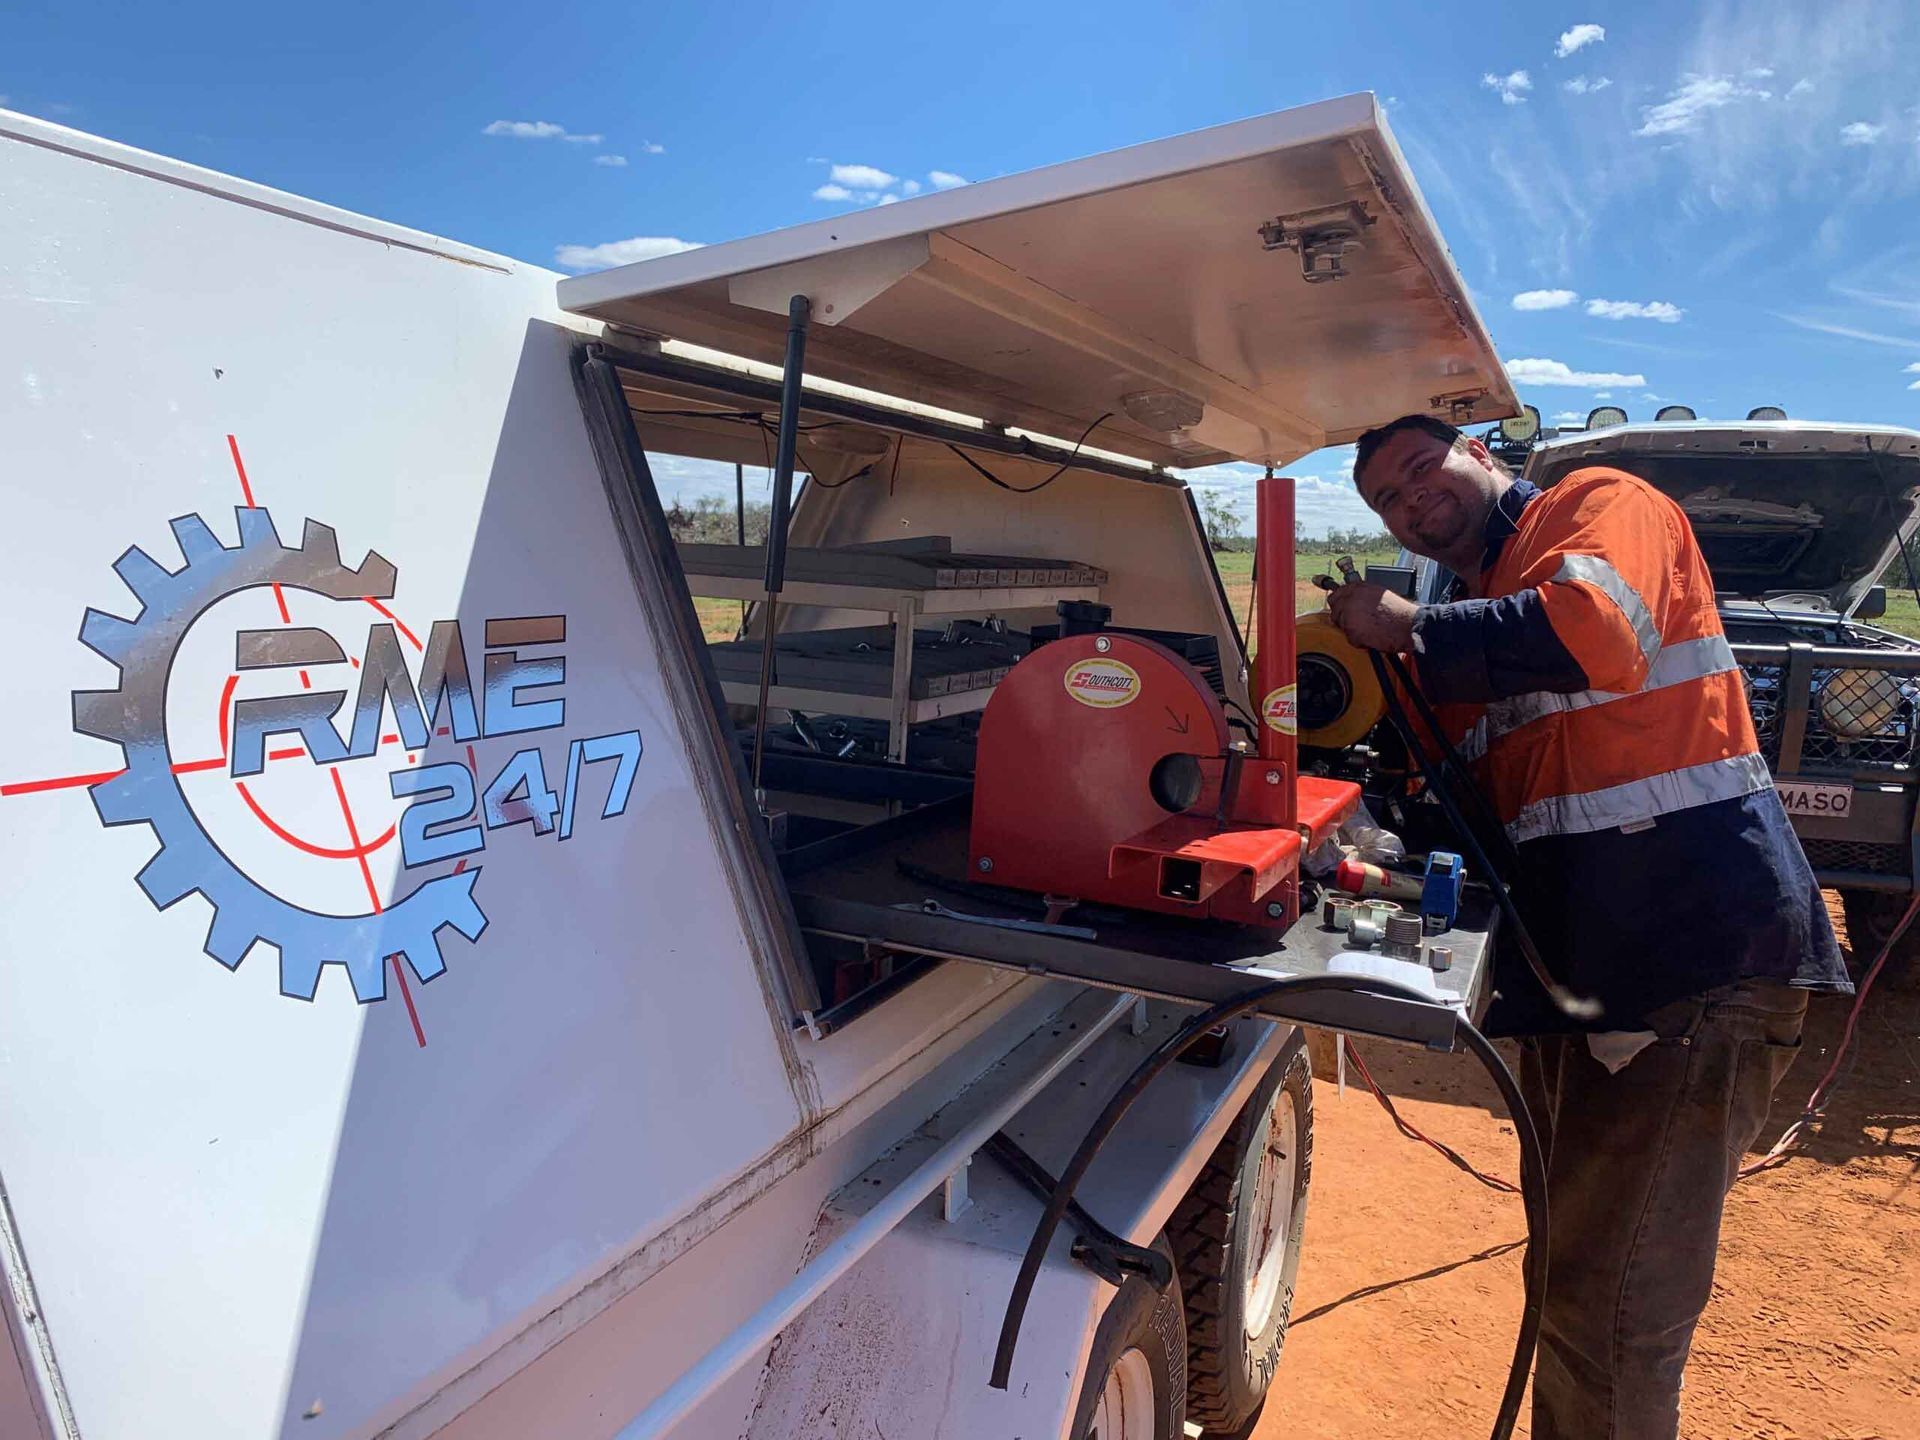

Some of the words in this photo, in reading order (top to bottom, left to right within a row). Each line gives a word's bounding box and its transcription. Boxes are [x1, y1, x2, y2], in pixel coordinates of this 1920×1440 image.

[231, 615, 566, 777] RME
[1070, 672, 1134, 688] SOUTHCOTT
[390, 730, 643, 869] 24/7
